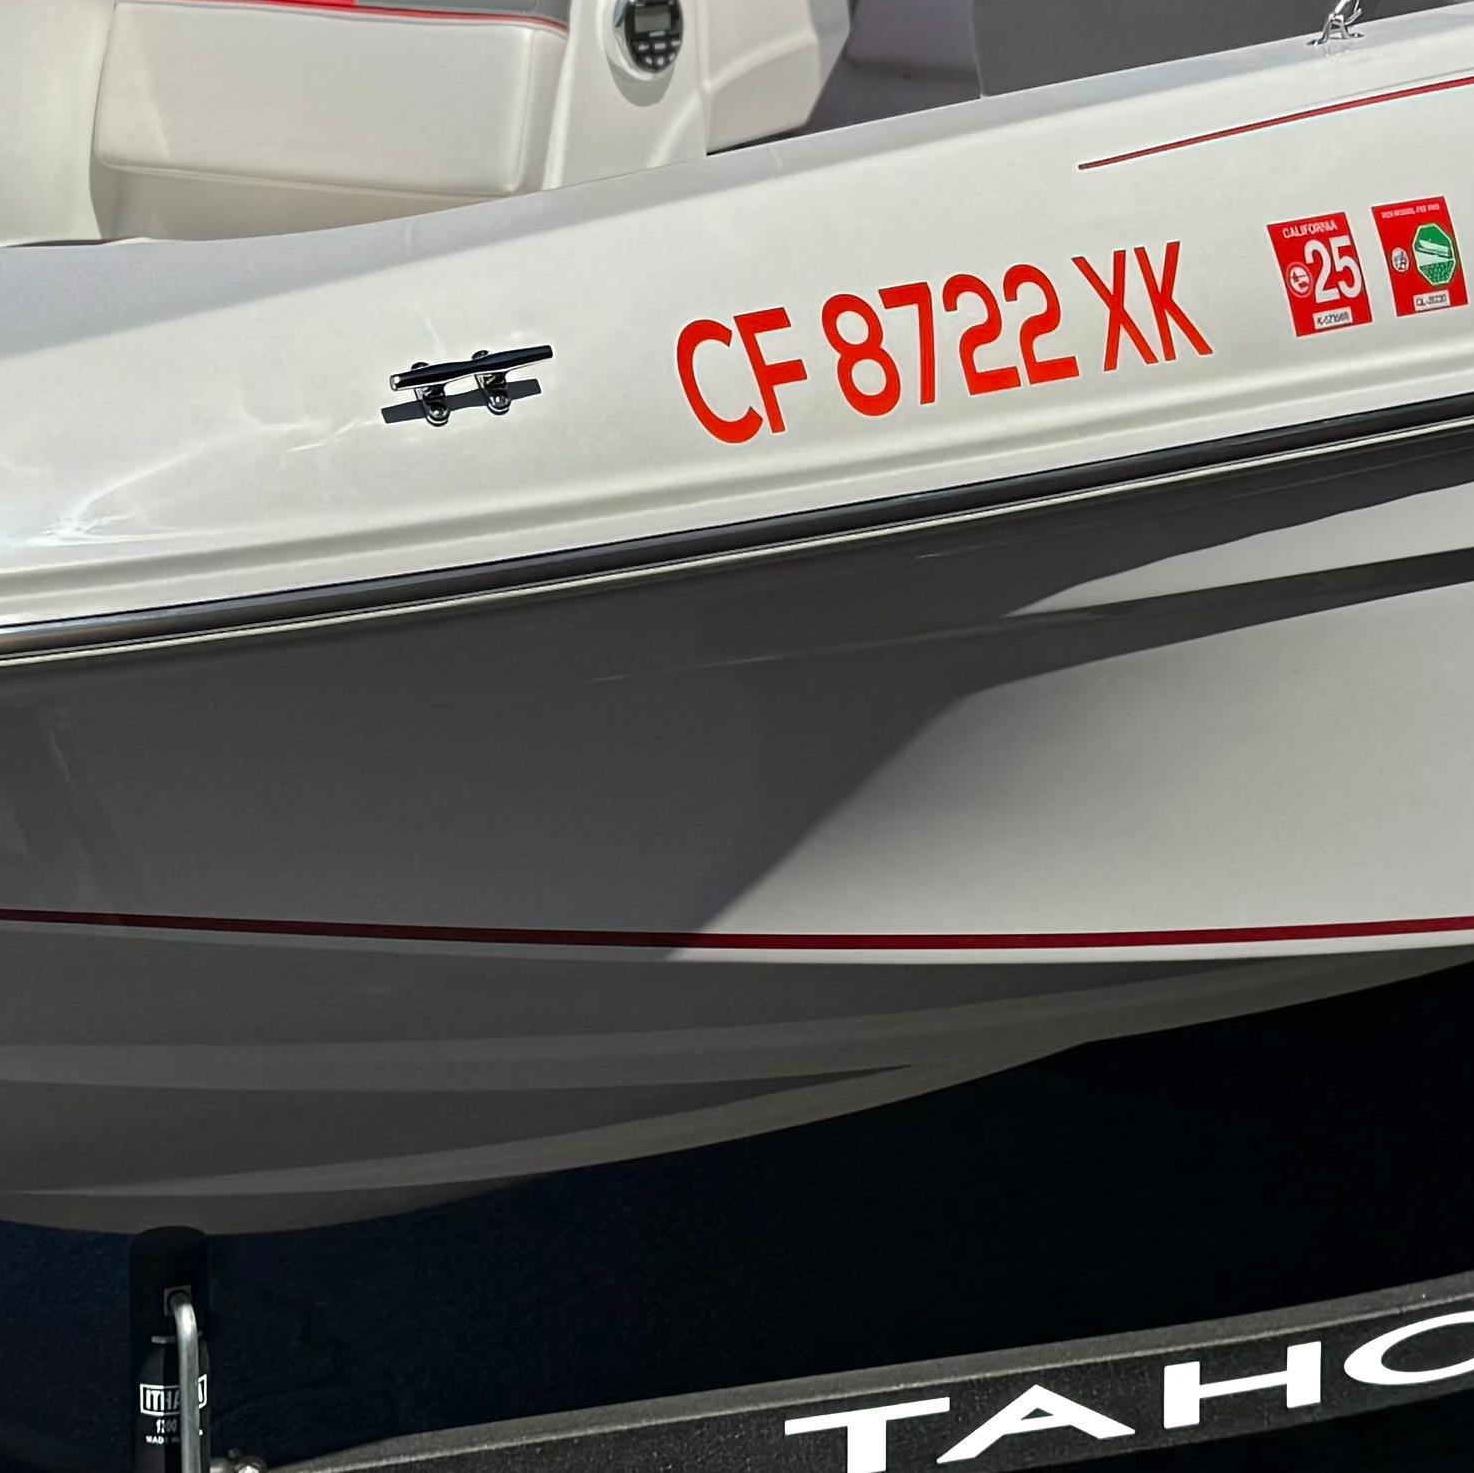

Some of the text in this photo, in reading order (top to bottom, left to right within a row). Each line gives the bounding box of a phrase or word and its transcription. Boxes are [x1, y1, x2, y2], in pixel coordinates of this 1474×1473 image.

[1304, 234, 1363, 303] 25
[676, 240, 1213, 444] CF 8722 XK
